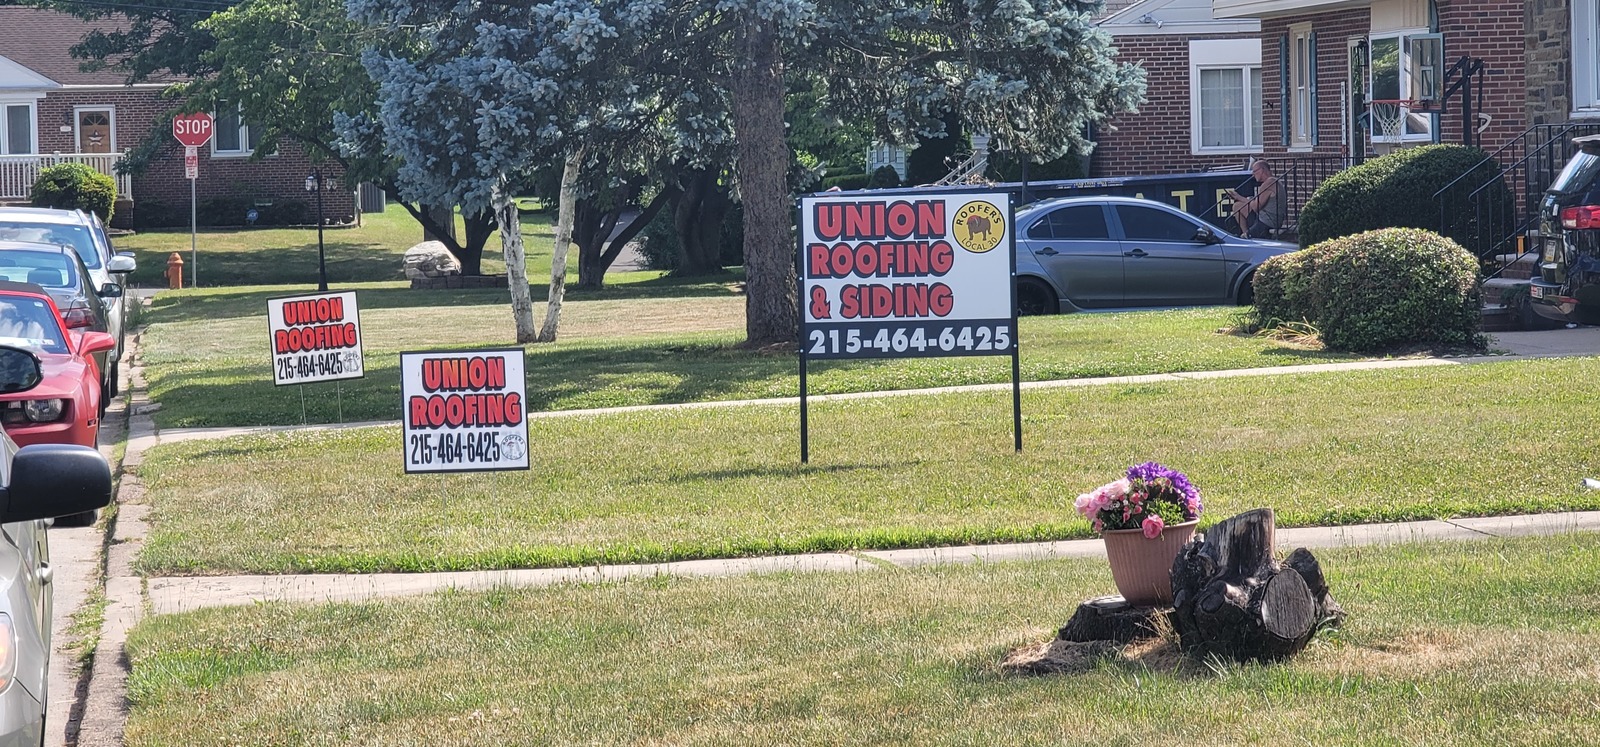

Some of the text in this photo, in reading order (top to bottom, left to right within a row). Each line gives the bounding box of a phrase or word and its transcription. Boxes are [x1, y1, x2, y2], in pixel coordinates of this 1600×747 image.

[176, 119, 210, 134] STOP
[813, 199, 947, 242] UNION
[956, 204, 1002, 226] ROOFERS
[806, 240, 955, 279] ROOFING
[961, 236, 998, 251] LOCAL 30
[282, 296, 344, 327] UNION
[809, 282, 954, 319] & SIDING
[274, 322, 357, 355] ROOFING
[808, 325, 1010, 354] 215-464-6425
[277, 352, 343, 380] 215-464-6425
[421, 356, 506, 392] UNION
[409, 391, 522, 430] ROOFING
[411, 431, 500, 465] 215-464-6425
